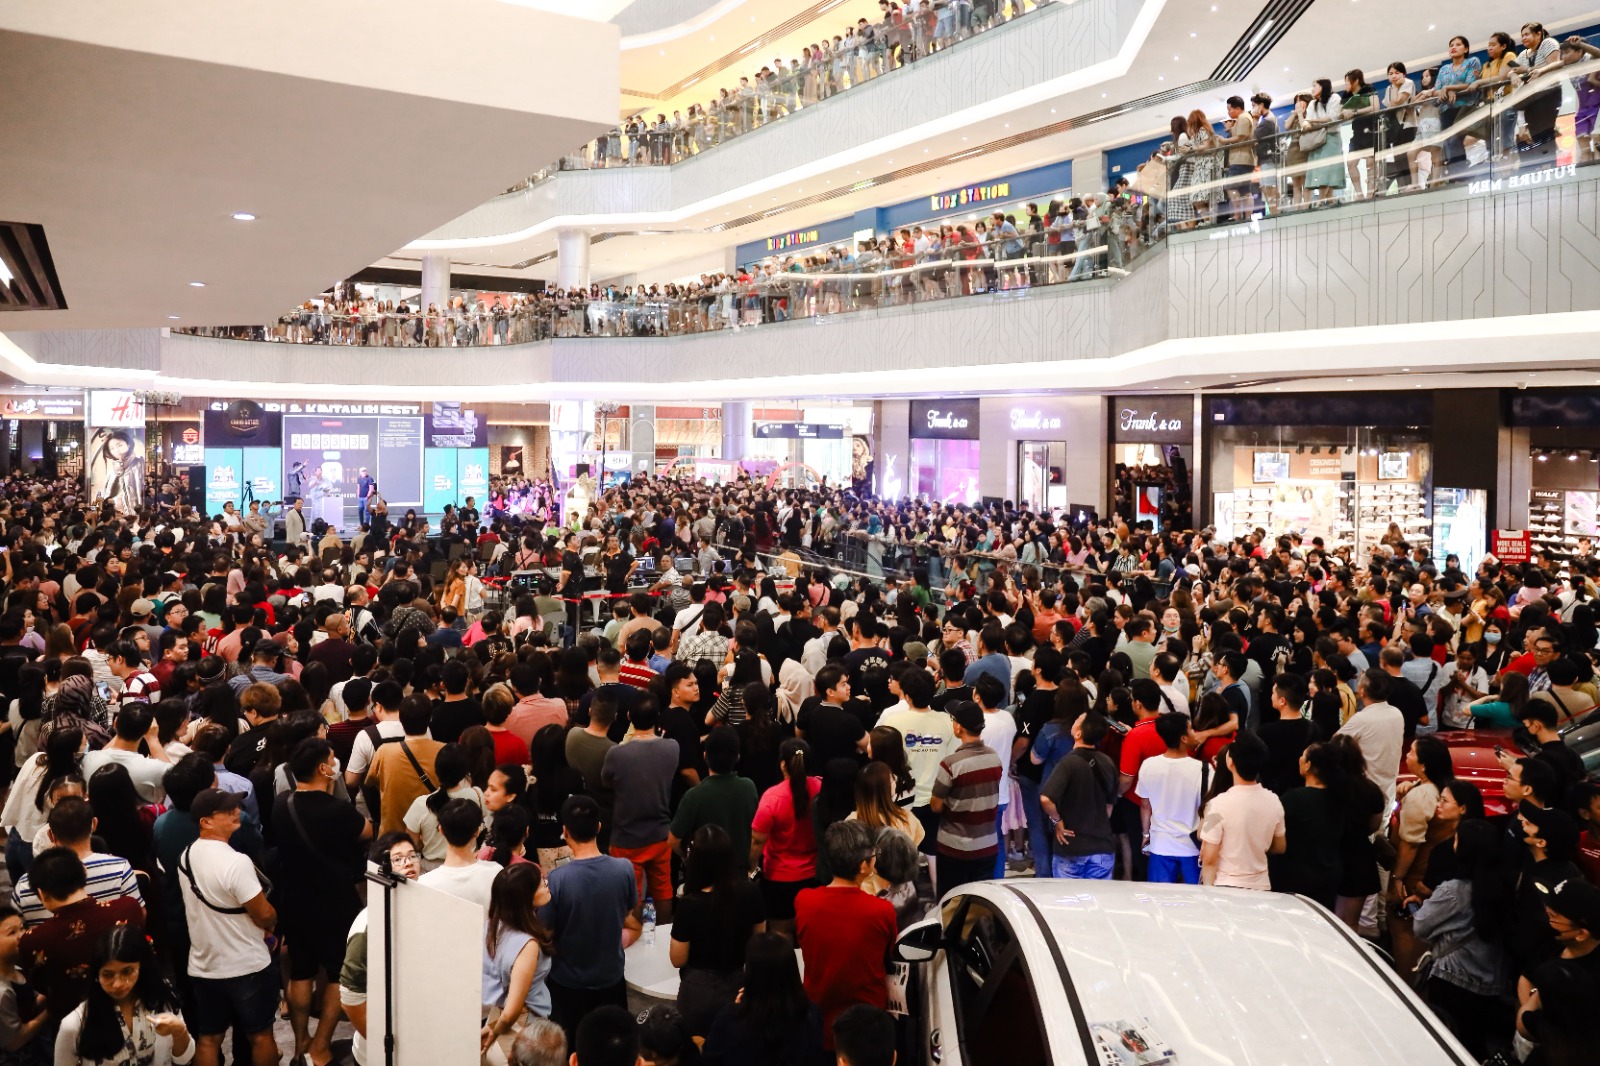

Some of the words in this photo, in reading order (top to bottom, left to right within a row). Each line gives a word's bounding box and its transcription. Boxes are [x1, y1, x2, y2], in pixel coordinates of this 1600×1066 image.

[931, 194, 958, 211] KIDZ
[960, 183, 1009, 204] STATION
[786, 230, 818, 246] STATION
[927, 409, 952, 429] Frank
[1010, 408, 1041, 430] Frank
[1120, 408, 1158, 431] Frank
[1158, 419, 1167, 430] &
[612, 457, 628, 465] BRI
[1509, 546, 1526, 554] POINTS
